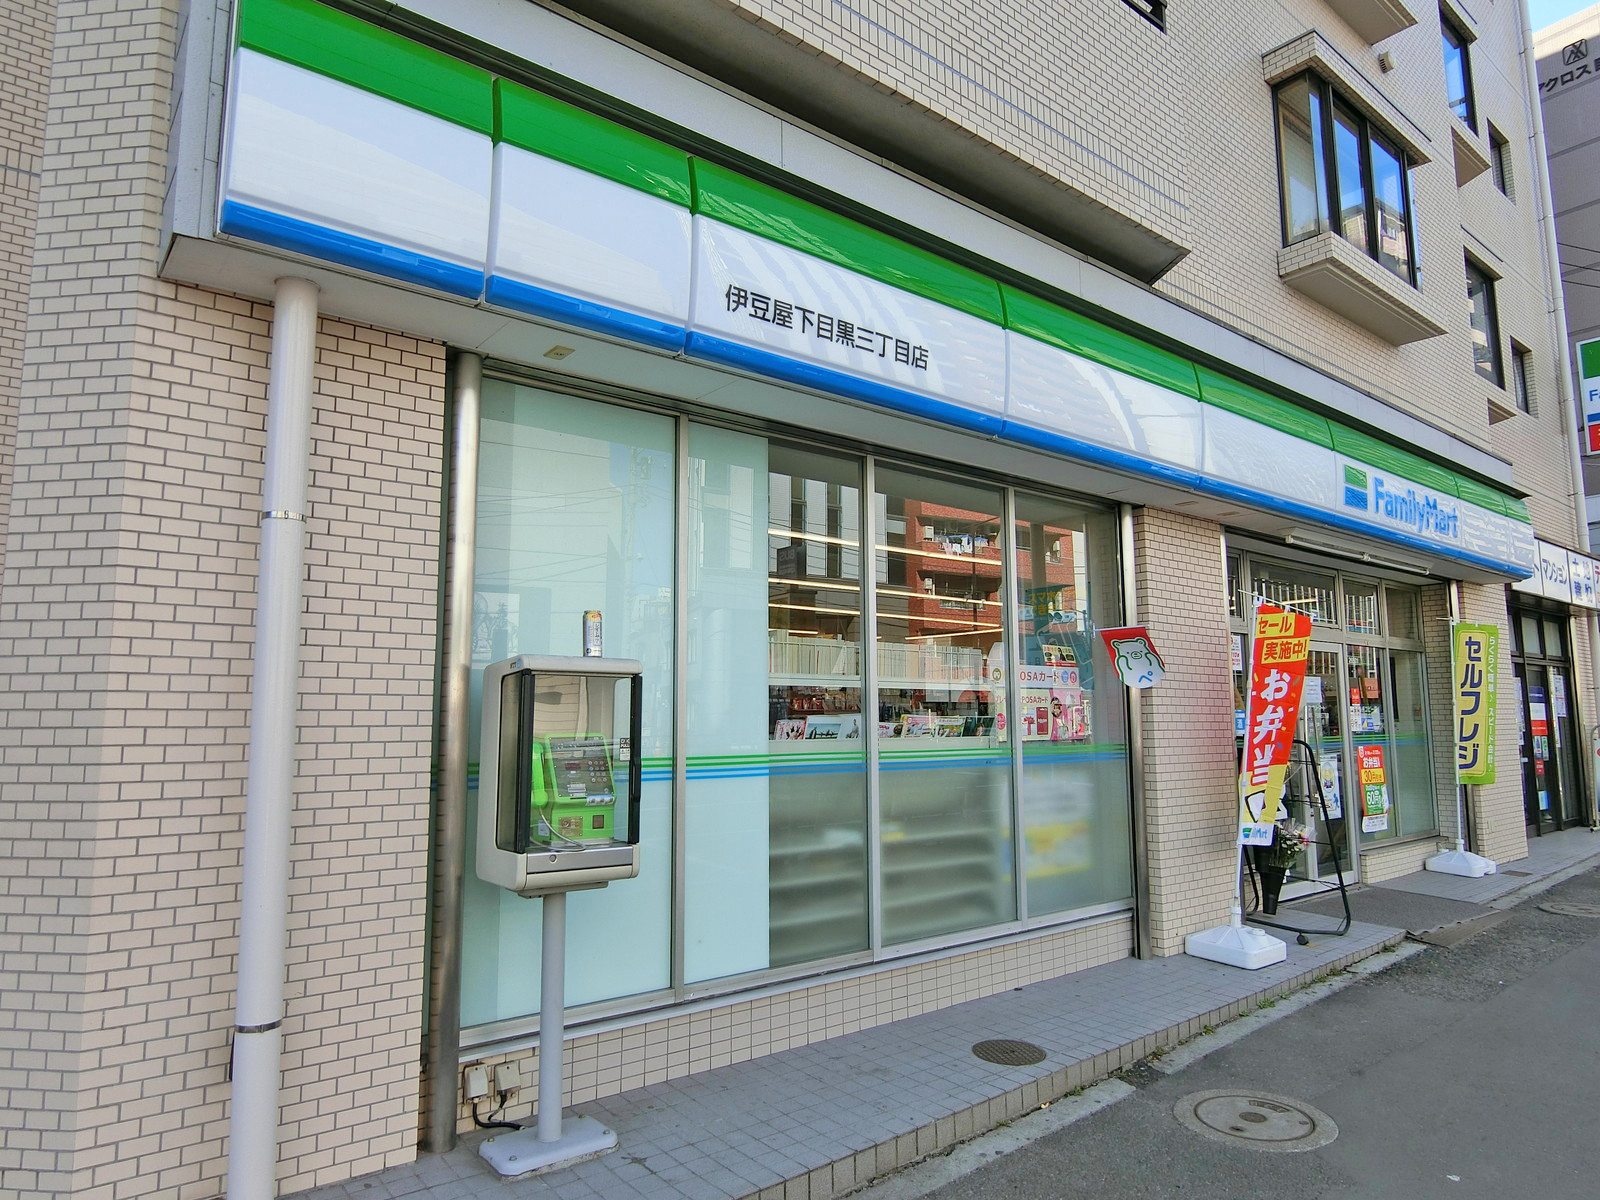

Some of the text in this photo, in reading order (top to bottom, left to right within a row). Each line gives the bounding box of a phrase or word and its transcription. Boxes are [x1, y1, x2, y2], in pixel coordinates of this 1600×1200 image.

[725, 284, 929, 371] 伊豆屋下目黒三丁目店
[1373, 476, 1458, 538] FamilyMart
[1542, 557, 1568, 585] マンション
[1259, 616, 1292, 634] セール
[1264, 639, 1308, 661] 実施中!
[1459, 636, 1483, 770] セルフレジ
